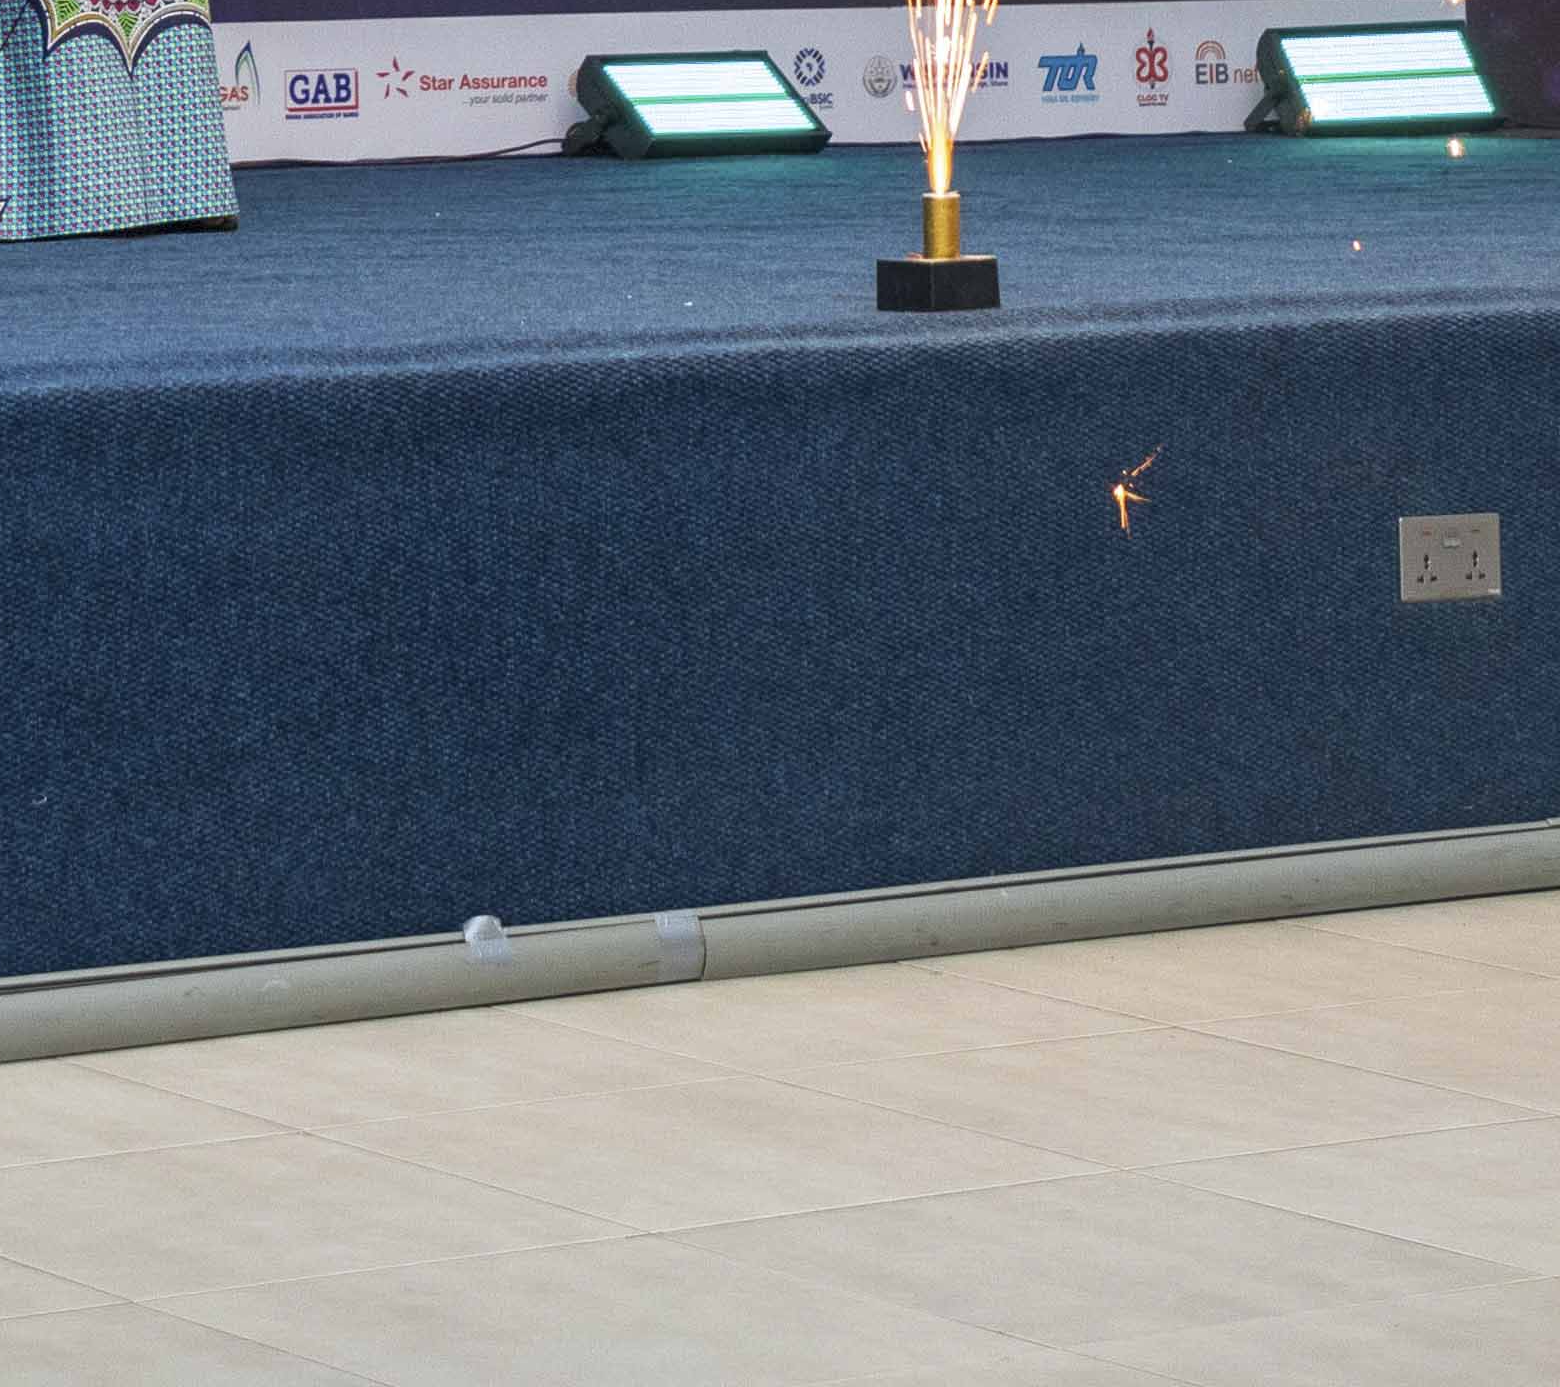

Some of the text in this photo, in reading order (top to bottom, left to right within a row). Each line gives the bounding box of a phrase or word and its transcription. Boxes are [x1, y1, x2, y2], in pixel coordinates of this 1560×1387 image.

[419, 73, 548, 92] Star Assurance
[1195, 63, 1229, 85] EIB
[289, 72, 353, 105] GAB
[518, 91, 549, 105] partner
